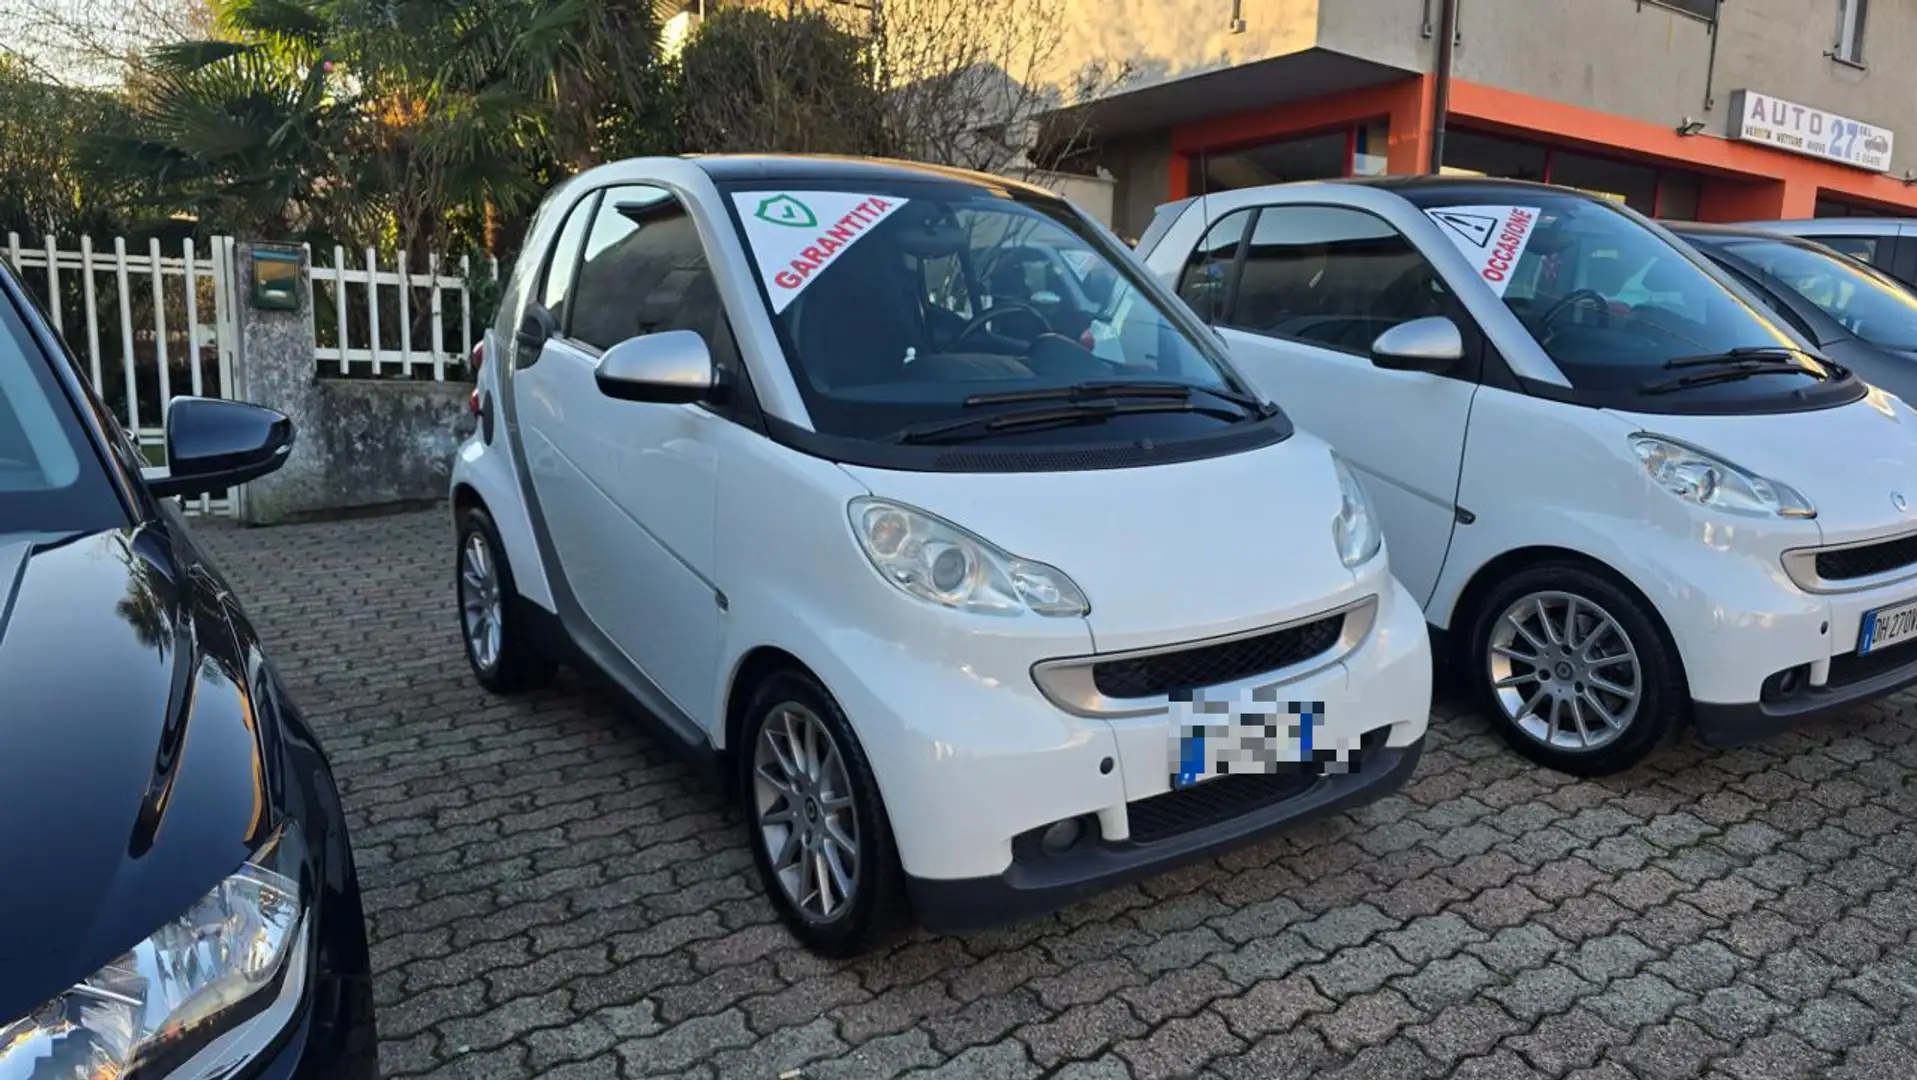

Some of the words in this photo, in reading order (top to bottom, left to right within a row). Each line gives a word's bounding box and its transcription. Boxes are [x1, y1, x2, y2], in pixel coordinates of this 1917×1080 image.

[1750, 96, 1823, 136] AUTO
[1828, 119, 1858, 160] 27
[774, 196, 893, 289] GARANTITA
[1482, 207, 1533, 282] OCCASIONE
